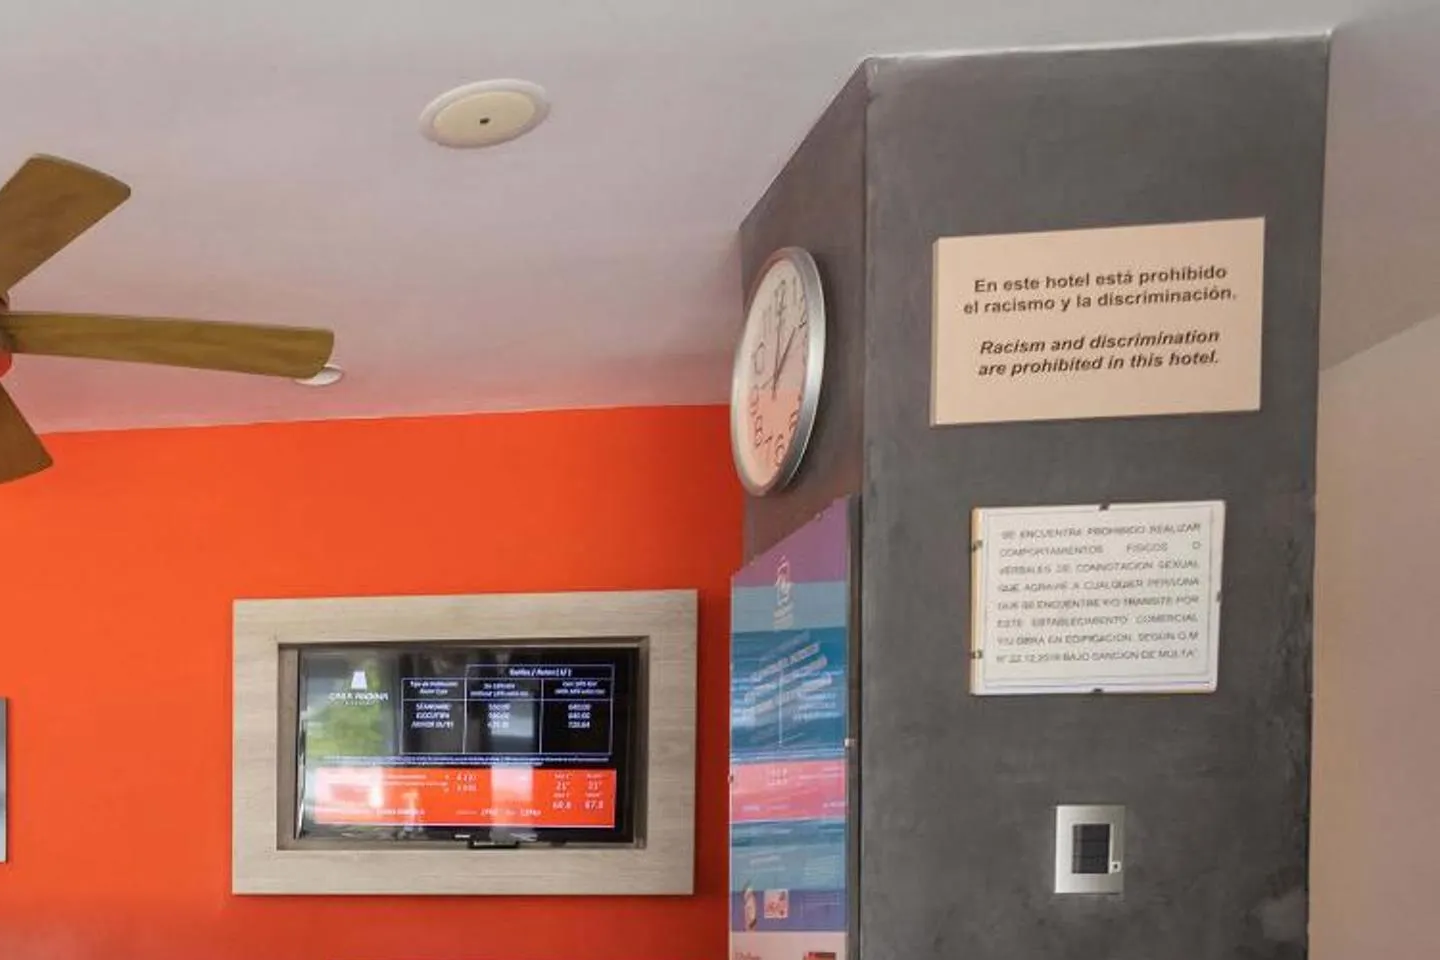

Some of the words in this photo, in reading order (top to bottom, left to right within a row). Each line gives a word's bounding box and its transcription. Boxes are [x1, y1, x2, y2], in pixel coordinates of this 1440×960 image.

[974, 279, 997, 293] En
[1003, 278, 1040, 292] este
[1046, 273, 1090, 289] hotel
[1096, 270, 1133, 286] está
[1139, 265, 1227, 286] prohibido
[963, 302, 979, 315] el
[984, 297, 1055, 313] racismo
[1061, 298, 1070, 313] y
[1076, 293, 1092, 308] la
[1097, 285, 1237, 308] discriminación.
[980, 339, 1045, 355] Racism
[1051, 336, 1085, 351] and
[1089, 329, 1220, 350] discrimination
[978, 362, 1006, 376] are
[1010, 355, 1103, 378] prohibited
[1108, 354, 1124, 370] in
[1131, 352, 1163, 368] this
[1168, 349, 1219, 366] hotel.
